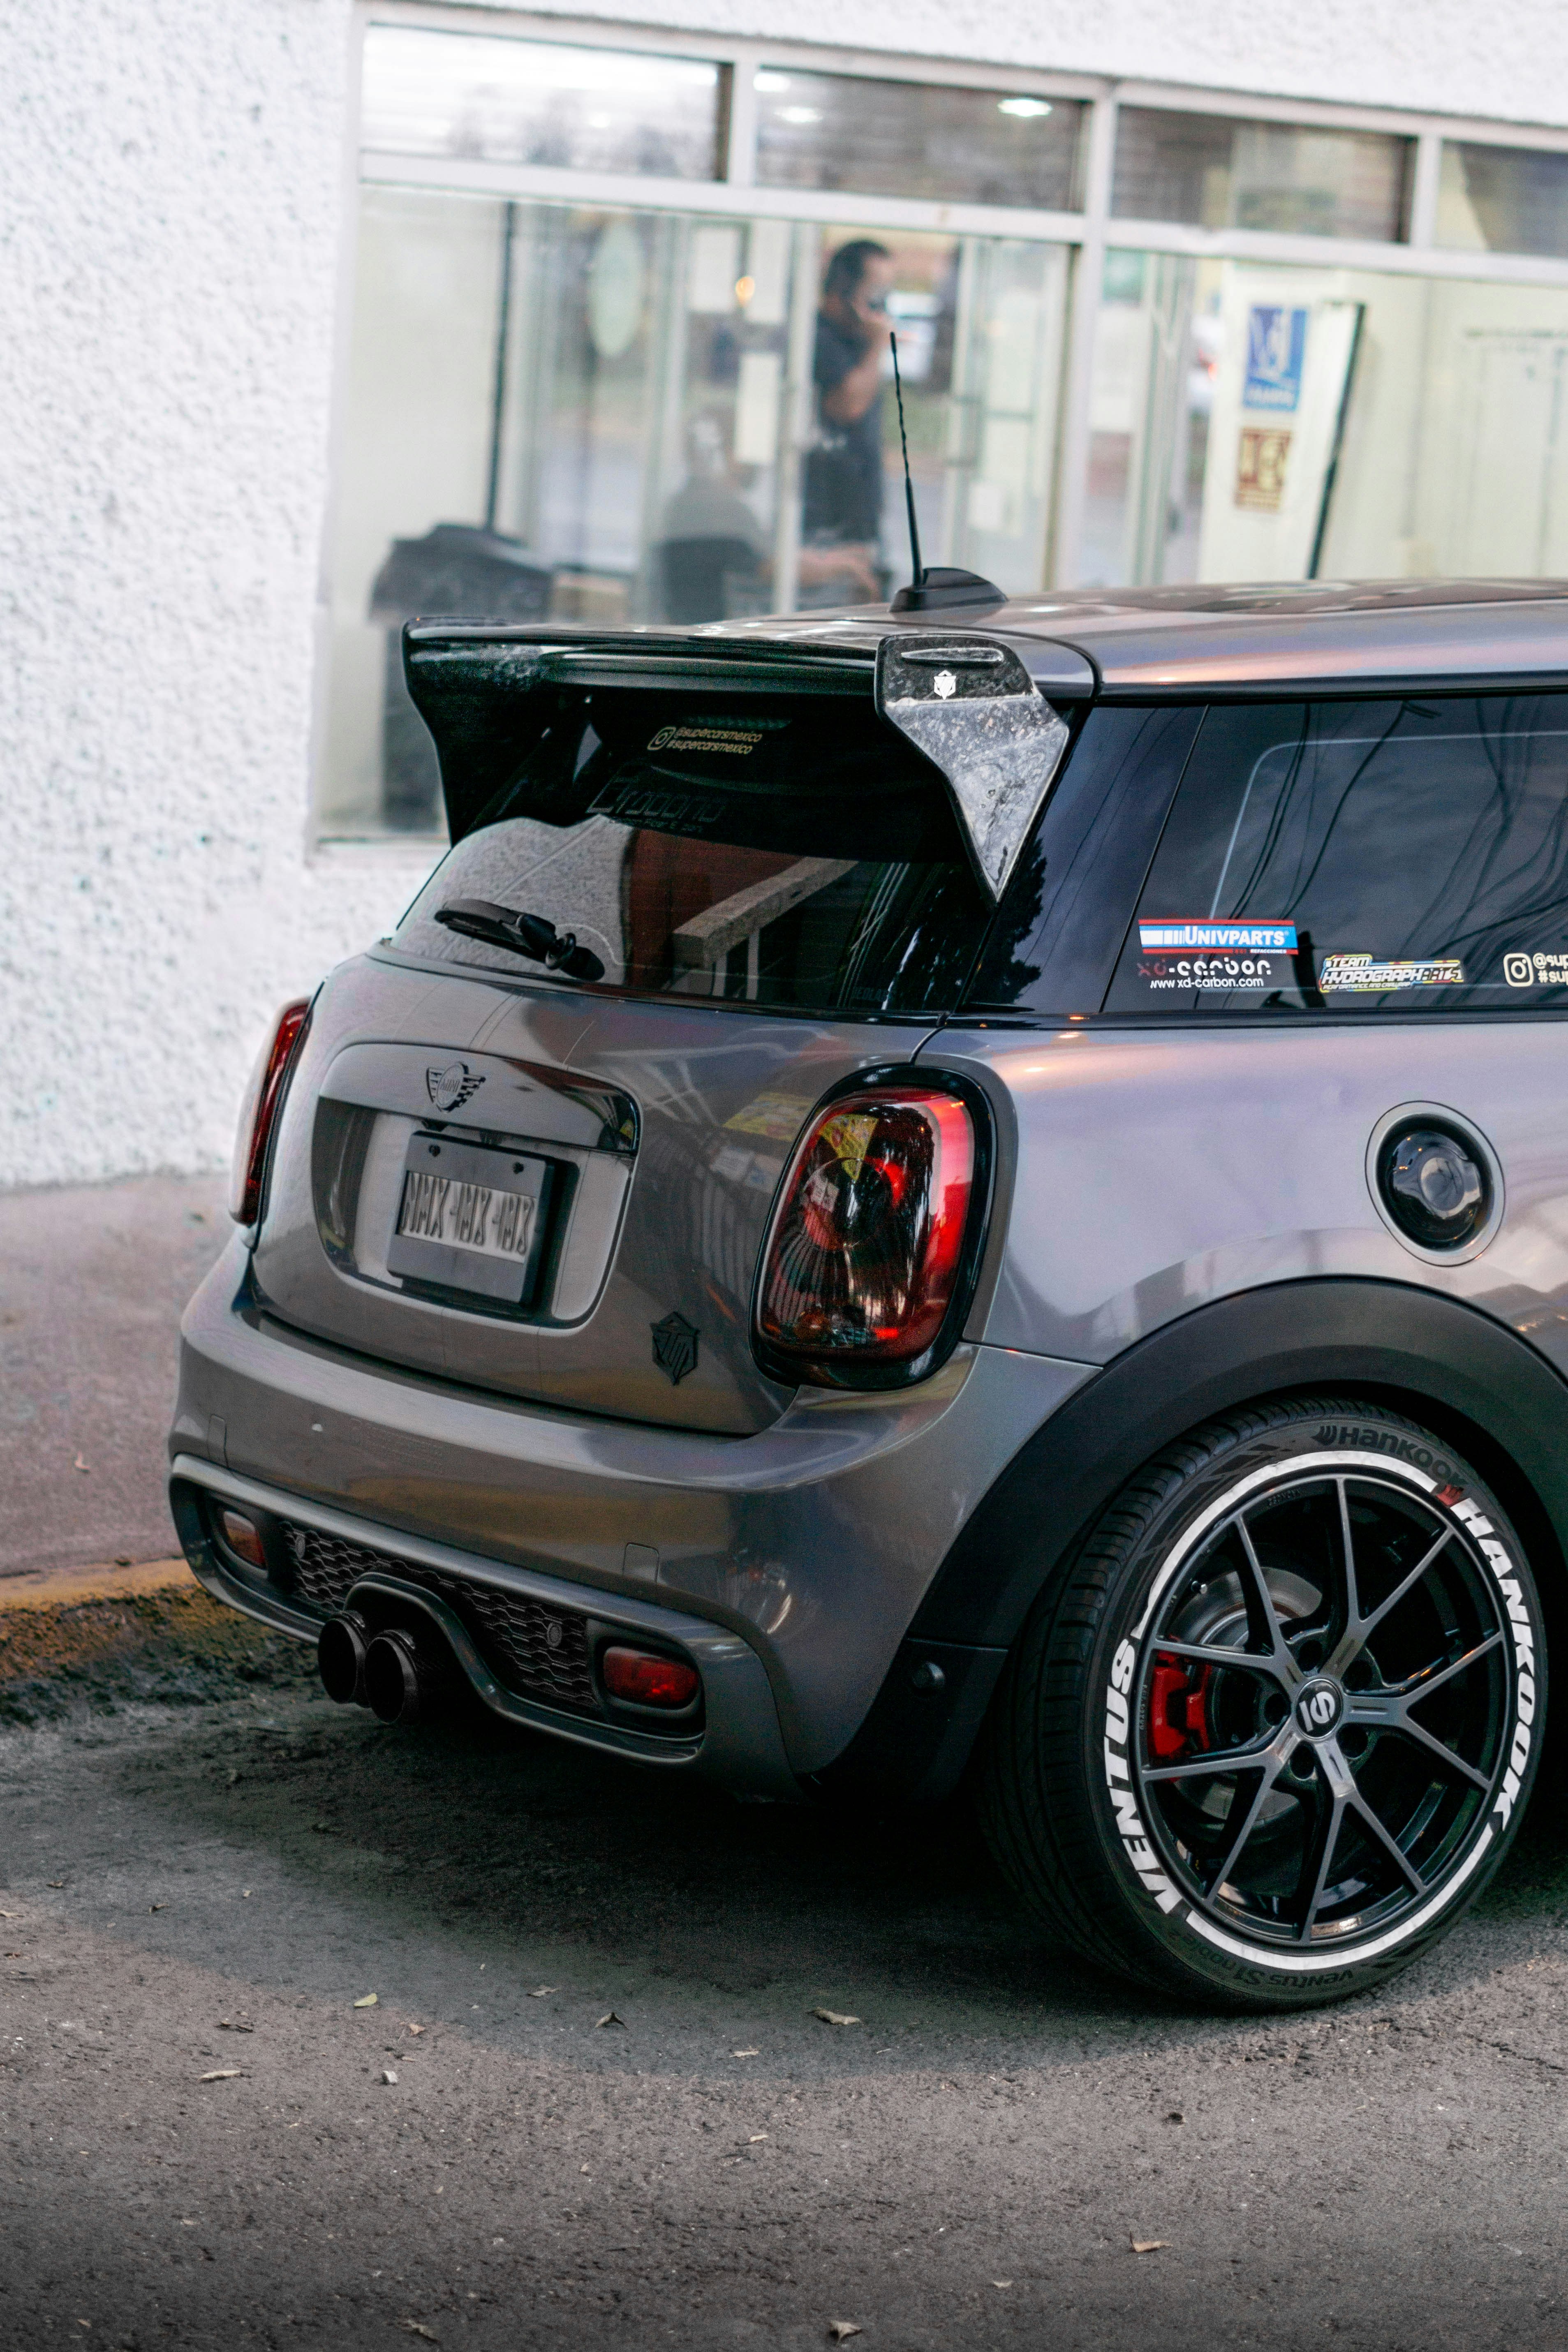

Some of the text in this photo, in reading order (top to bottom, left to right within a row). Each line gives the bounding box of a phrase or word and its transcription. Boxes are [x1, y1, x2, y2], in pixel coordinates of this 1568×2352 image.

[1150, 977, 1264, 989] wwwxd-carbon.com
[1332, 957, 1370, 967] TEAM
[1450, 1498, 1536, 1832] HANKOOK
[1104, 1638, 1183, 1914] VENTUS
